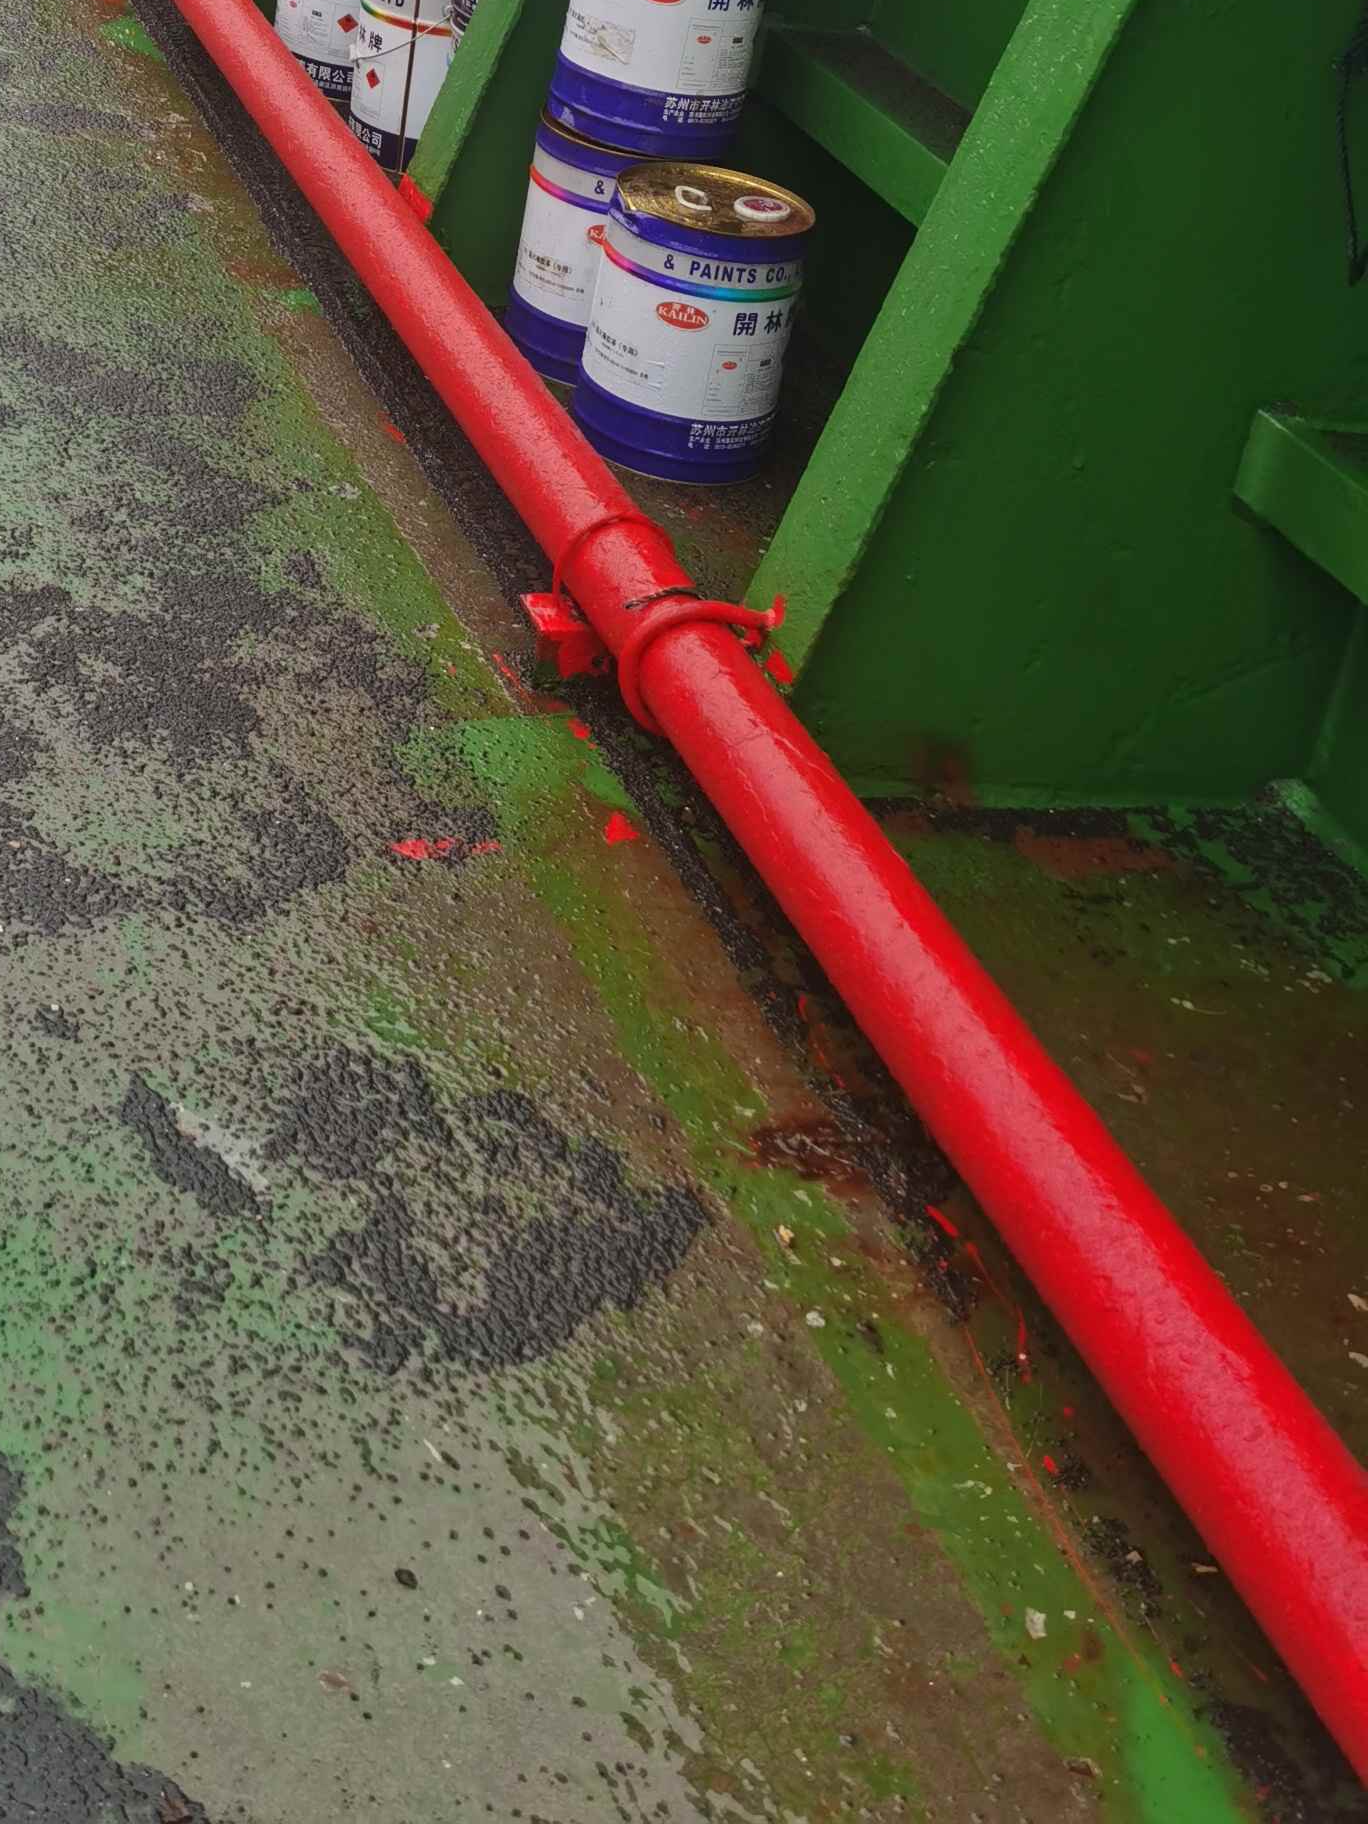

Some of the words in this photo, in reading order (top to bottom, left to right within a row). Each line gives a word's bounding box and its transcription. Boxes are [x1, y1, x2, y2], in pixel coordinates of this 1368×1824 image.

[594, 179, 606, 195] &
[664, 254, 675, 271] &
[689, 261, 757, 284] PAINTS
[659, 306, 707, 325] KAILIN
